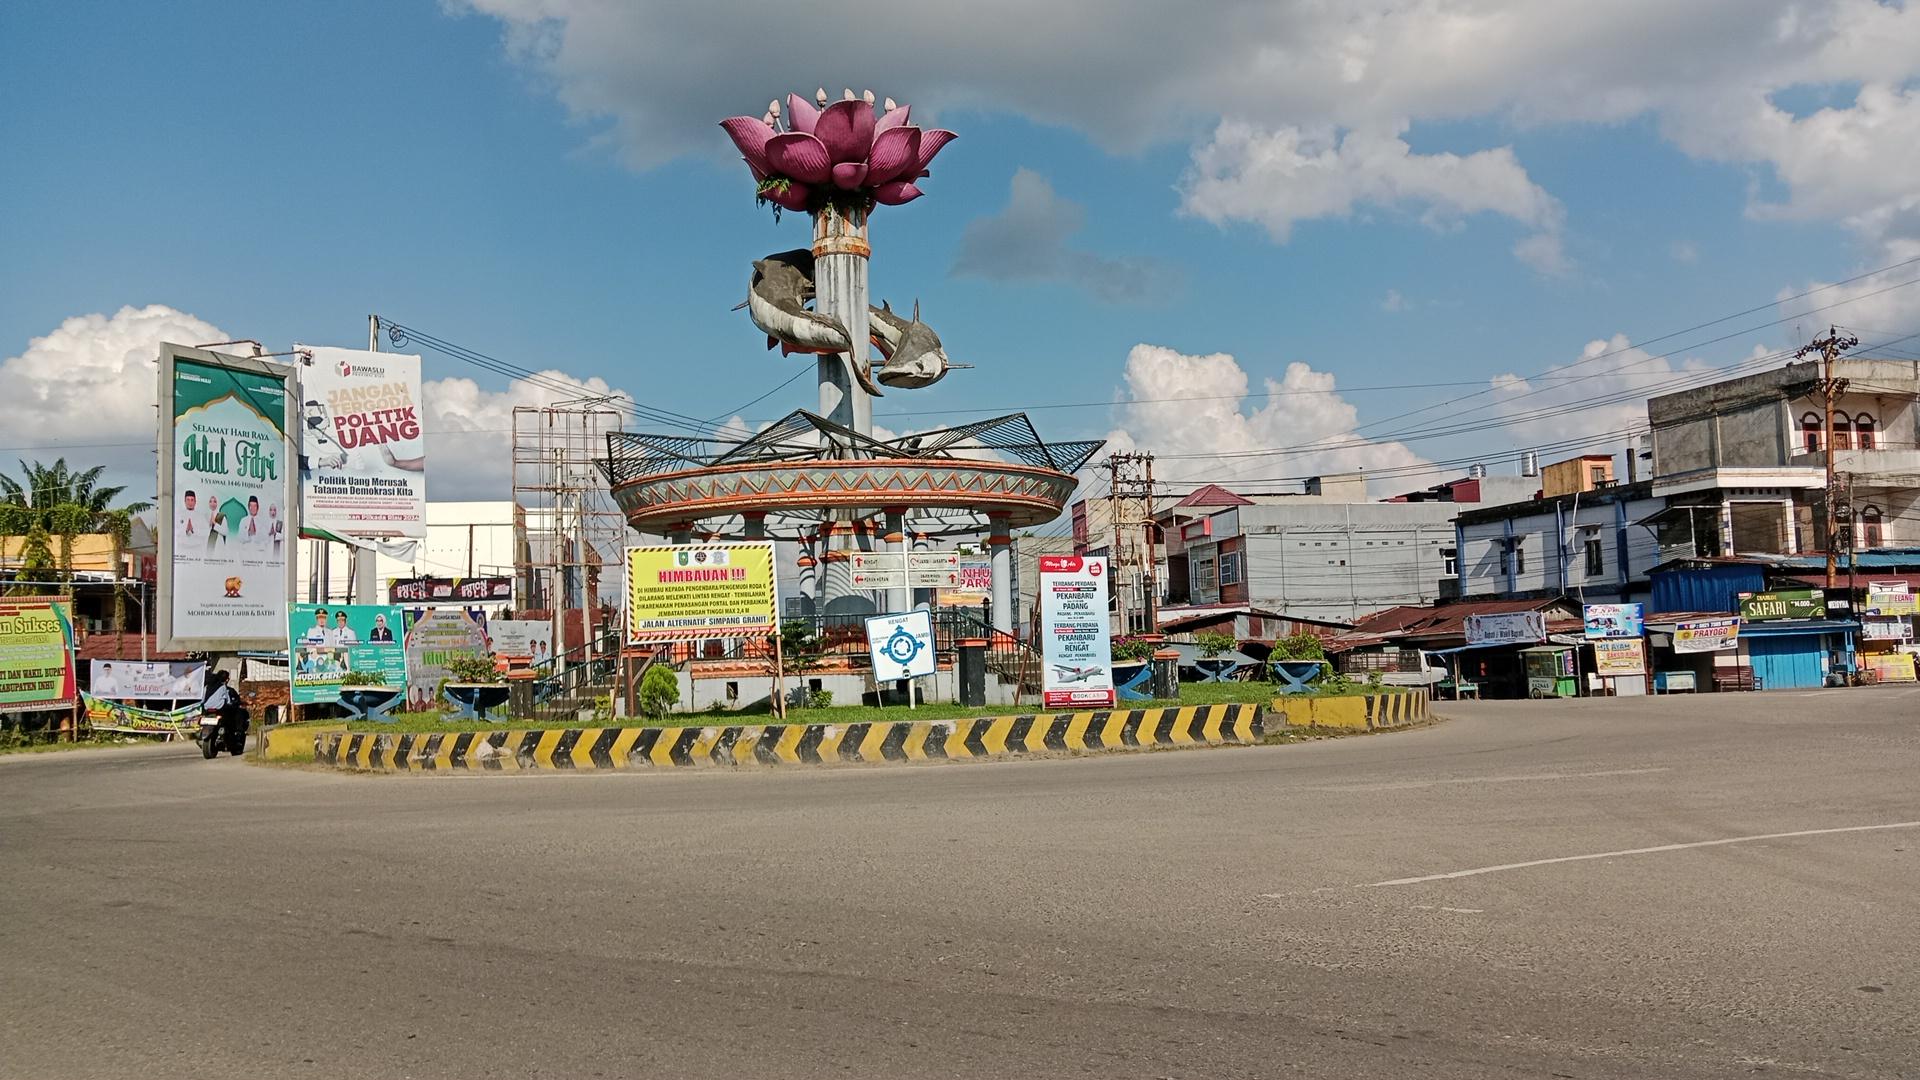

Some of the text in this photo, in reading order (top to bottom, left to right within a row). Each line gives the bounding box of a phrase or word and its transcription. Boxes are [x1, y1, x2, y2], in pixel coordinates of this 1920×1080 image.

[352, 365, 384, 374] BAWASLU
[328, 382, 408, 404] JANGAN
[330, 396, 412, 416] TERGODA
[334, 406, 416, 430] POLITIK
[192, 423, 270, 440] SELAMAT HARI RAYA
[337, 420, 420, 449] UANG
[183, 434, 228, 474] Idul
[318, 476, 408, 487] Politik Uang Merusak
[313, 485, 413, 496] Tatanan Demokrasi Kita
[658, 568, 745, 583] HIMBAUAN !!!
[961, 568, 990, 578] NHU
[960, 578, 990, 588] PARK
[637, 602, 674, 610] DIKARENAKAN
[1749, 601, 1786, 616] SAFARI
[14, 616, 61, 634] Sukses
[642, 616, 766, 628] JALAN ALTERNATIF SIMPANG GRANIT
[1693, 628, 1728, 638] PRAYOGO
[8, 670, 22, 680] DAN
[23, 668, 44, 679] WAKIL
